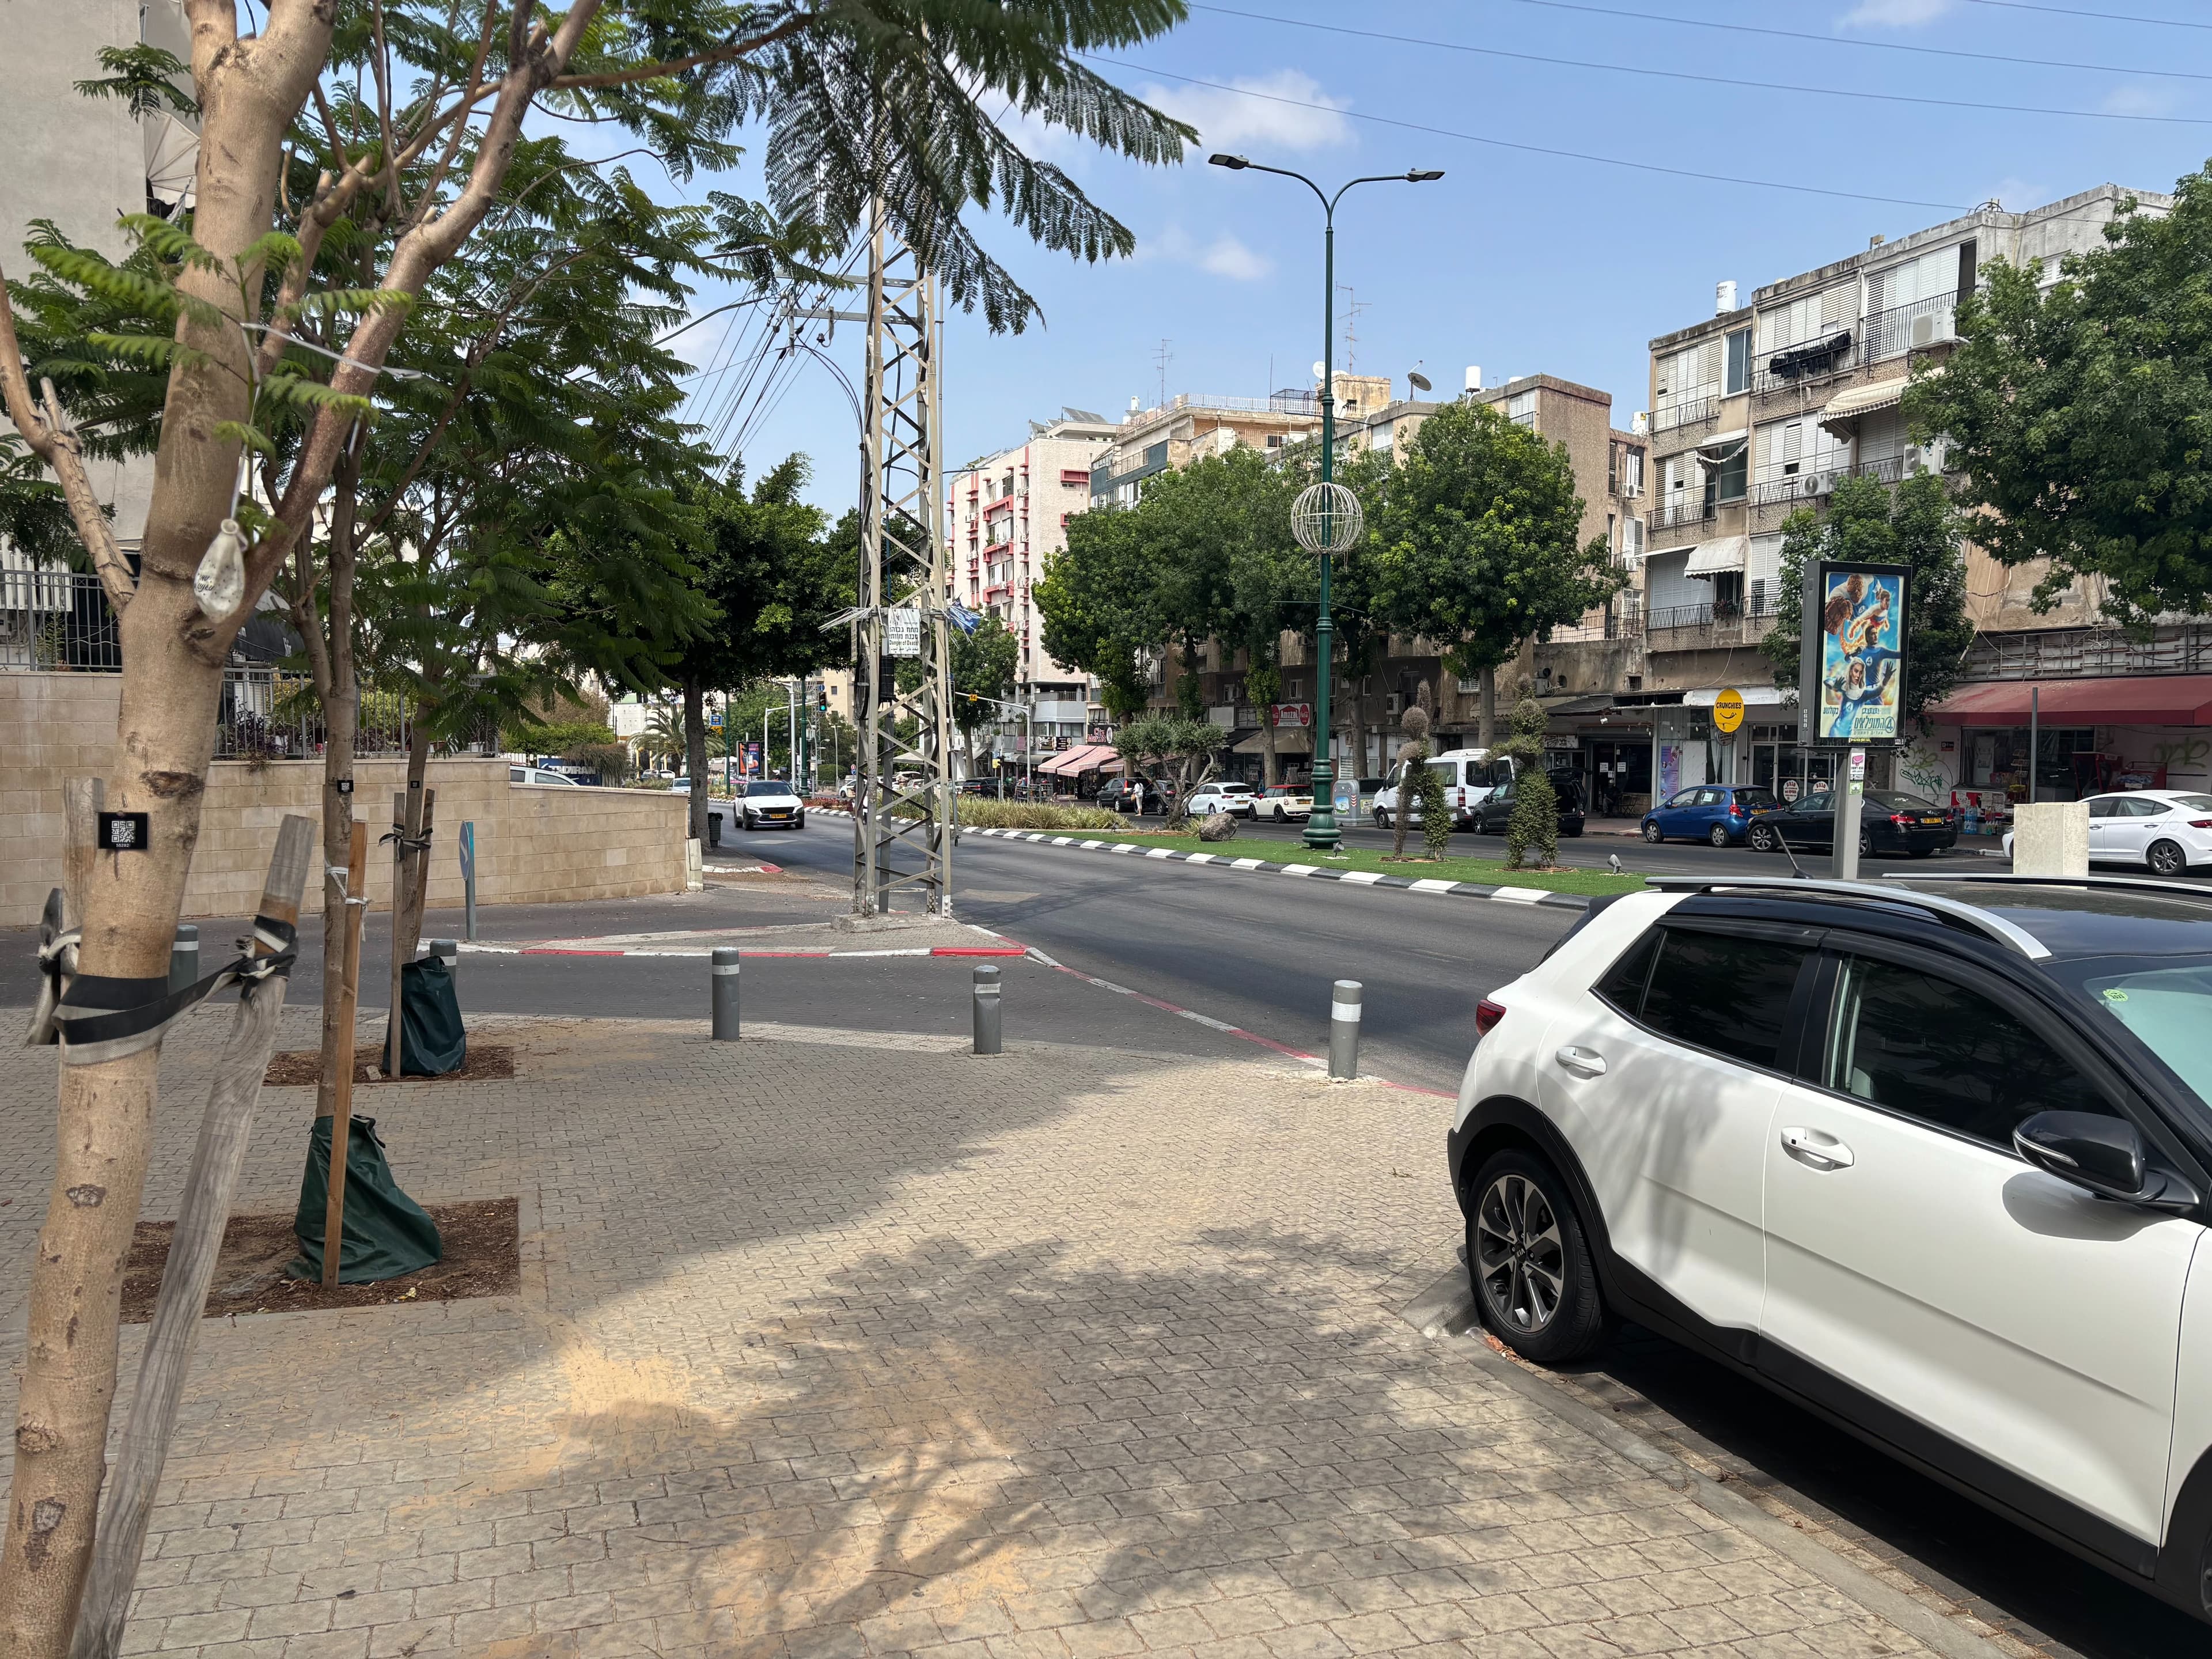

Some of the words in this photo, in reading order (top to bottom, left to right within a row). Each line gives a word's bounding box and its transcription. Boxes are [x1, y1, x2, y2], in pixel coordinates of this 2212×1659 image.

[1823, 706, 1839, 717] בקולנוע
[1854, 715, 1885, 729] המופלאים
[548, 766, 596, 774] TADIRAN
[1517, 1248, 1525, 1257] KIA
